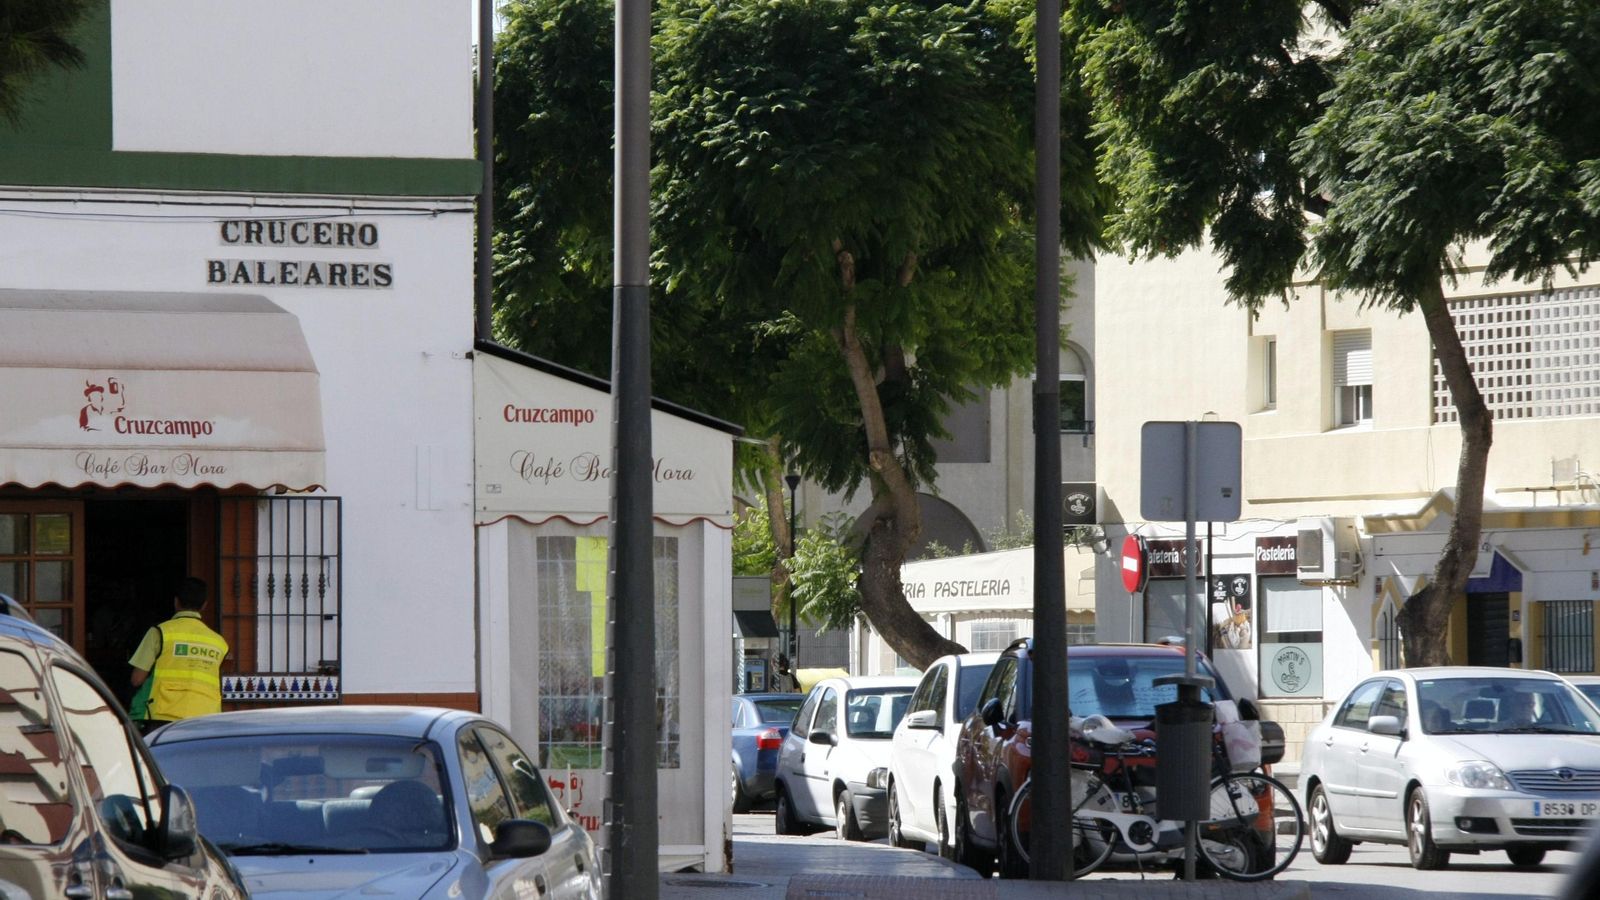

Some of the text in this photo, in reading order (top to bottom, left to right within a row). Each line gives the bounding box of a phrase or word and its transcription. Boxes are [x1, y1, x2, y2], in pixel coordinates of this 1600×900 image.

[221, 221, 378, 246] CRUCERO
[207, 260, 393, 287] BALEARES
[114, 415, 213, 438] Cruzcampo
[504, 404, 594, 427] Cruzcampo
[75, 452, 120, 479] Café
[124, 453, 168, 476] Bar
[510, 450, 565, 485] Café
[569, 451, 611, 482] Ba
[1148, 547, 1180, 564] afetería
[1256, 543, 1295, 561] Pastelería
[934, 579, 1010, 598] PASTELERIA
[1580, 803, 1600, 816] DP
